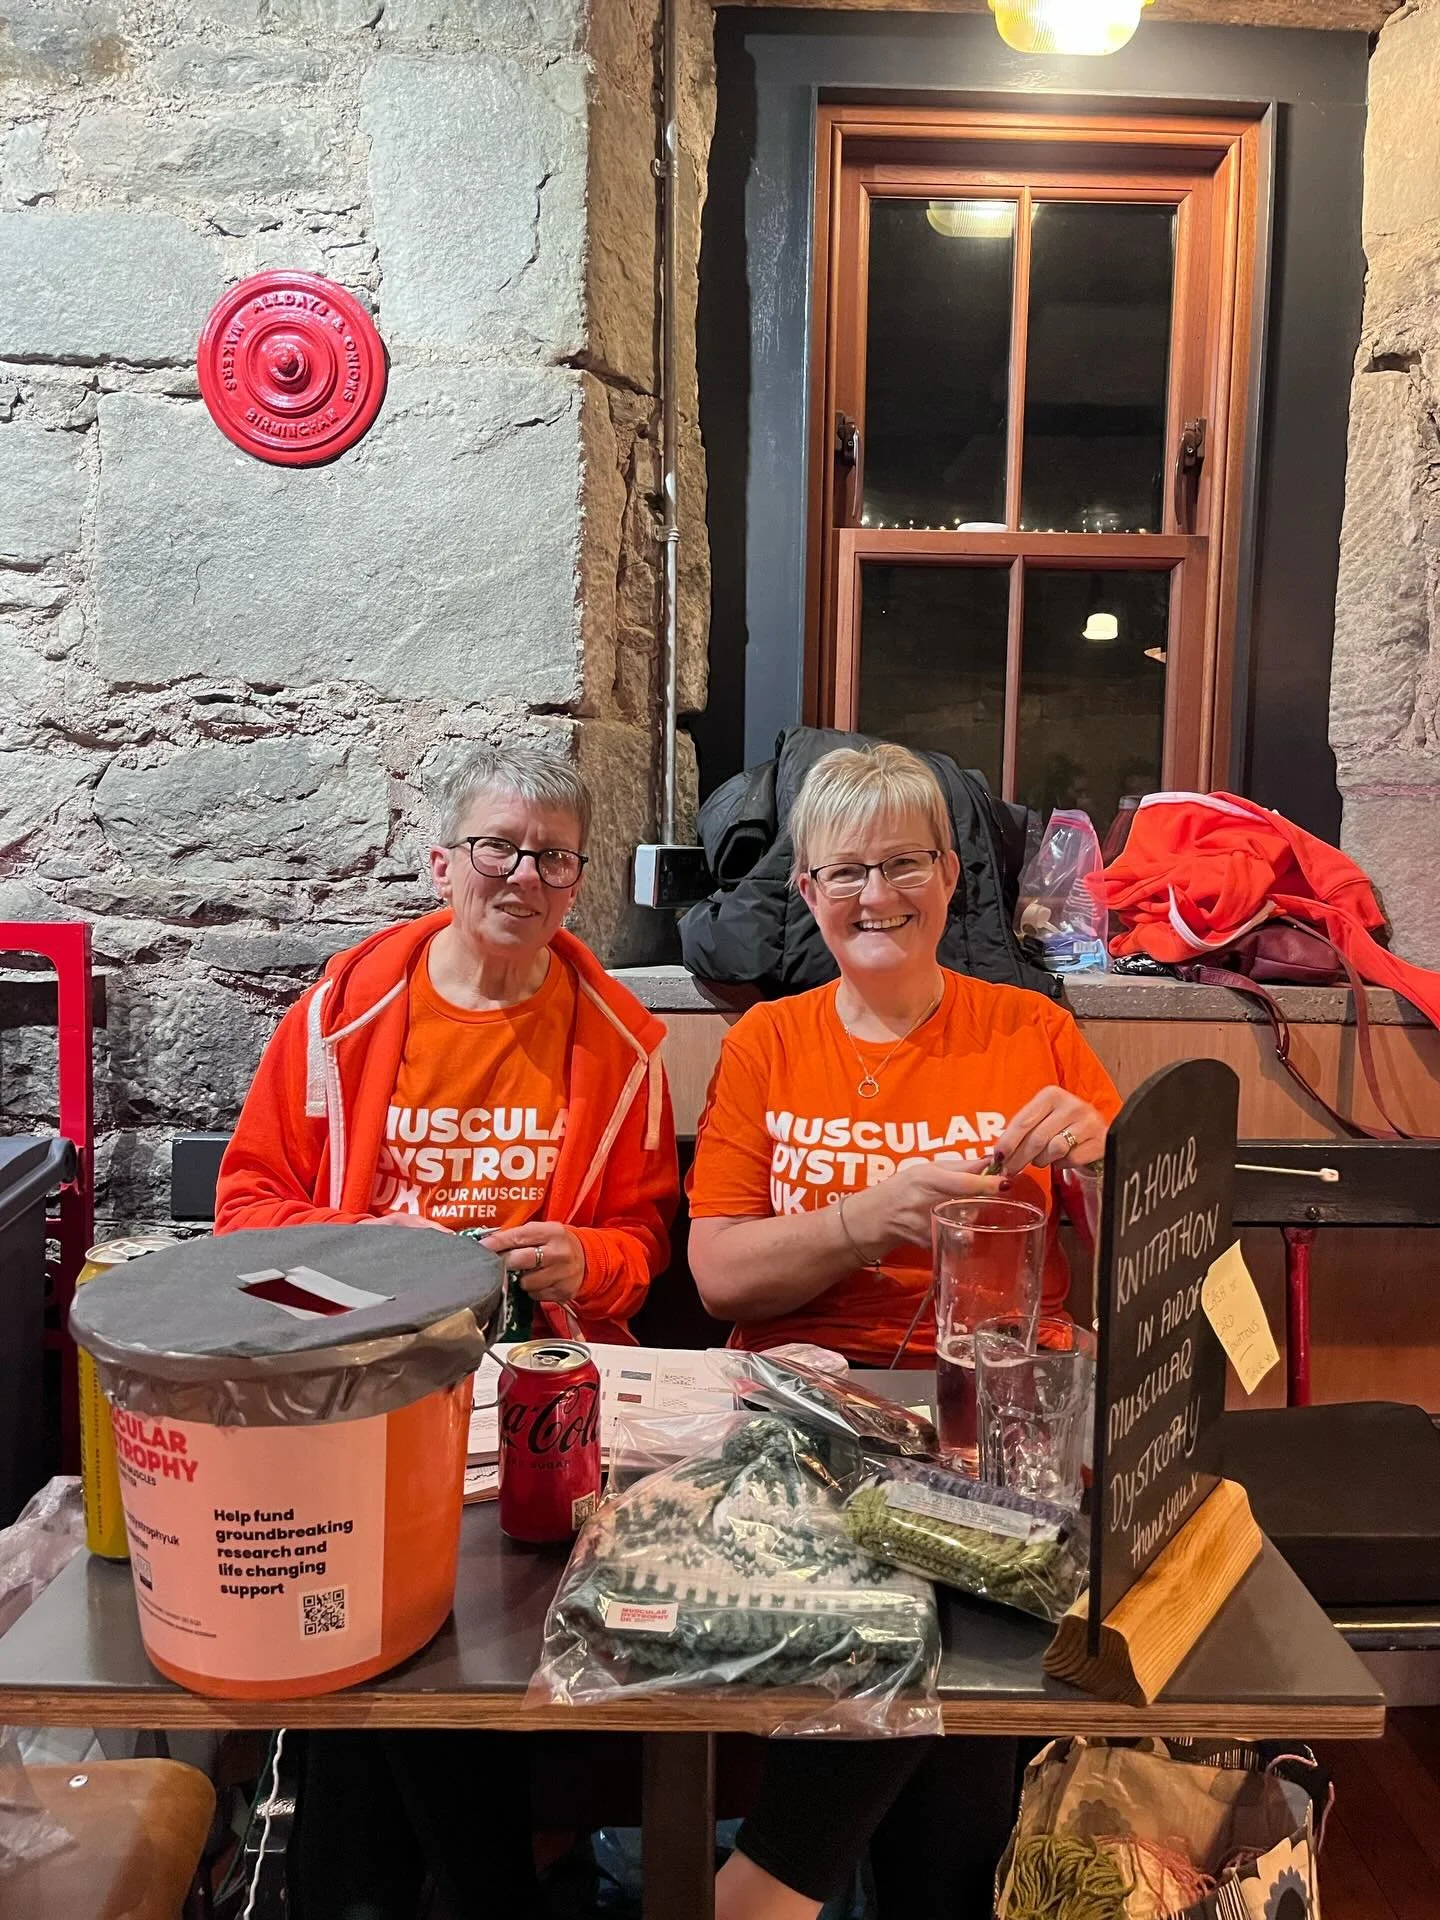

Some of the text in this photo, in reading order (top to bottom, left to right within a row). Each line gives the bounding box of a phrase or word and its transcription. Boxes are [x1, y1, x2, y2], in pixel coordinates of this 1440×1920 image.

[221, 319, 245, 393] MAKERS
[342, 335, 362, 405] ONIONS
[765, 1109, 1006, 1154] MUSCULAR
[371, 1173, 422, 1216] UK
[434, 1186, 545, 1201] OUR MUSCLES
[769, 1174, 808, 1217] UK
[1120, 1135, 1198, 1237] 12 HOUR
[431, 1204, 497, 1219] MATTER
[1116, 1202, 1220, 1313] KNITATHON
[1136, 1314, 1154, 1358] IN
[1107, 1338, 1193, 1456] MUSCULAR
[214, 1508, 295, 1526] Help fund
[215, 1519, 354, 1543] groundbreaking
[1165, 1485, 1192, 1537] you
[217, 1540, 328, 1559] research and
[218, 1561, 326, 1579] life changing
[220, 1582, 285, 1599] support
